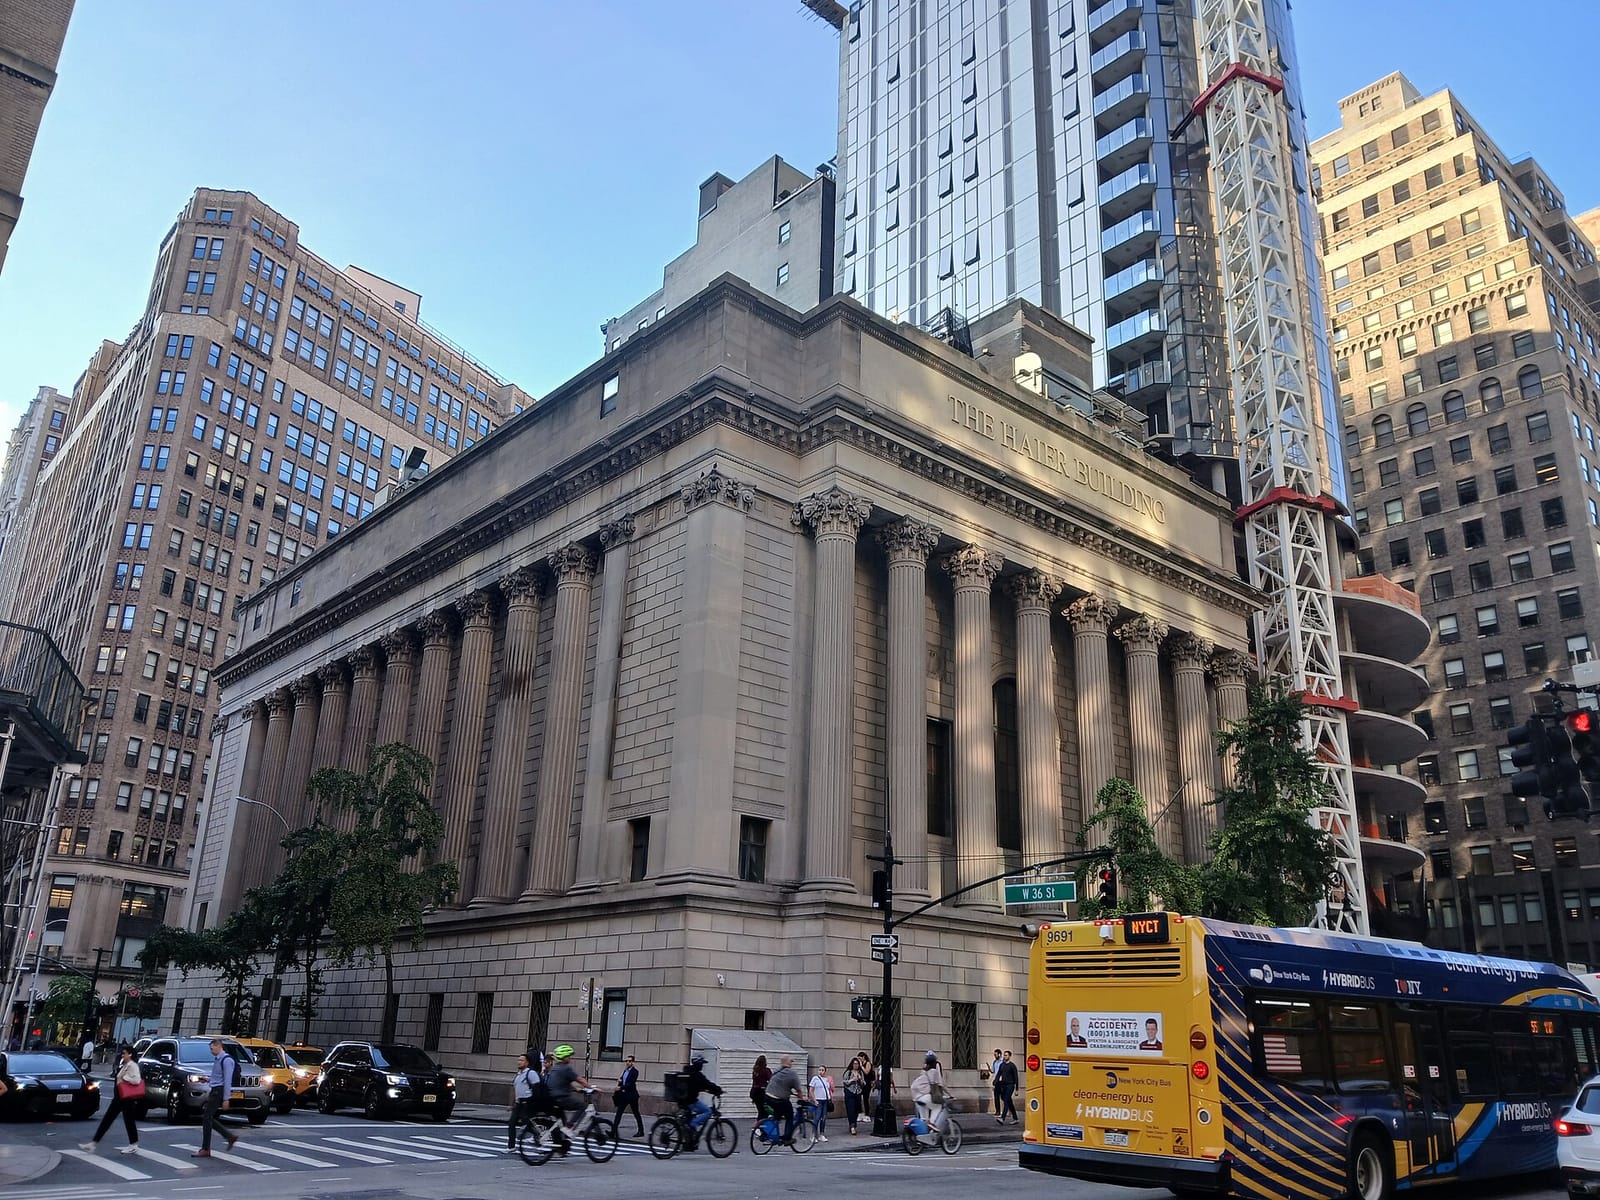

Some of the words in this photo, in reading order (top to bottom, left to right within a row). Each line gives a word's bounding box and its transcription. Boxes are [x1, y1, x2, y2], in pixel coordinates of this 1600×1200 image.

[948, 394, 995, 440] THE
[1000, 420, 1070, 479] HAIER
[1073, 458, 1166, 524] BUILDING
[1022, 889, 1030, 900] W
[1032, 888, 1043, 899] 36
[1046, 887, 1055, 898] St
[1132, 920, 1159, 934] NYCT
[1047, 930, 1073, 943] 9691
[1329, 972, 1375, 990] HYBRIDBUS
[1088, 1021, 1138, 1030] ACCIDENT?
[1146, 1078, 1158, 1087] City
[1159, 1079, 1172, 1087] Bus
[1073, 1089, 1133, 1104] clean-energy
[1136, 1091, 1154, 1104] bus
[1085, 1105, 1153, 1122] HYBRIDBUS
[1503, 1102, 1550, 1121] HYBRIDBUS
